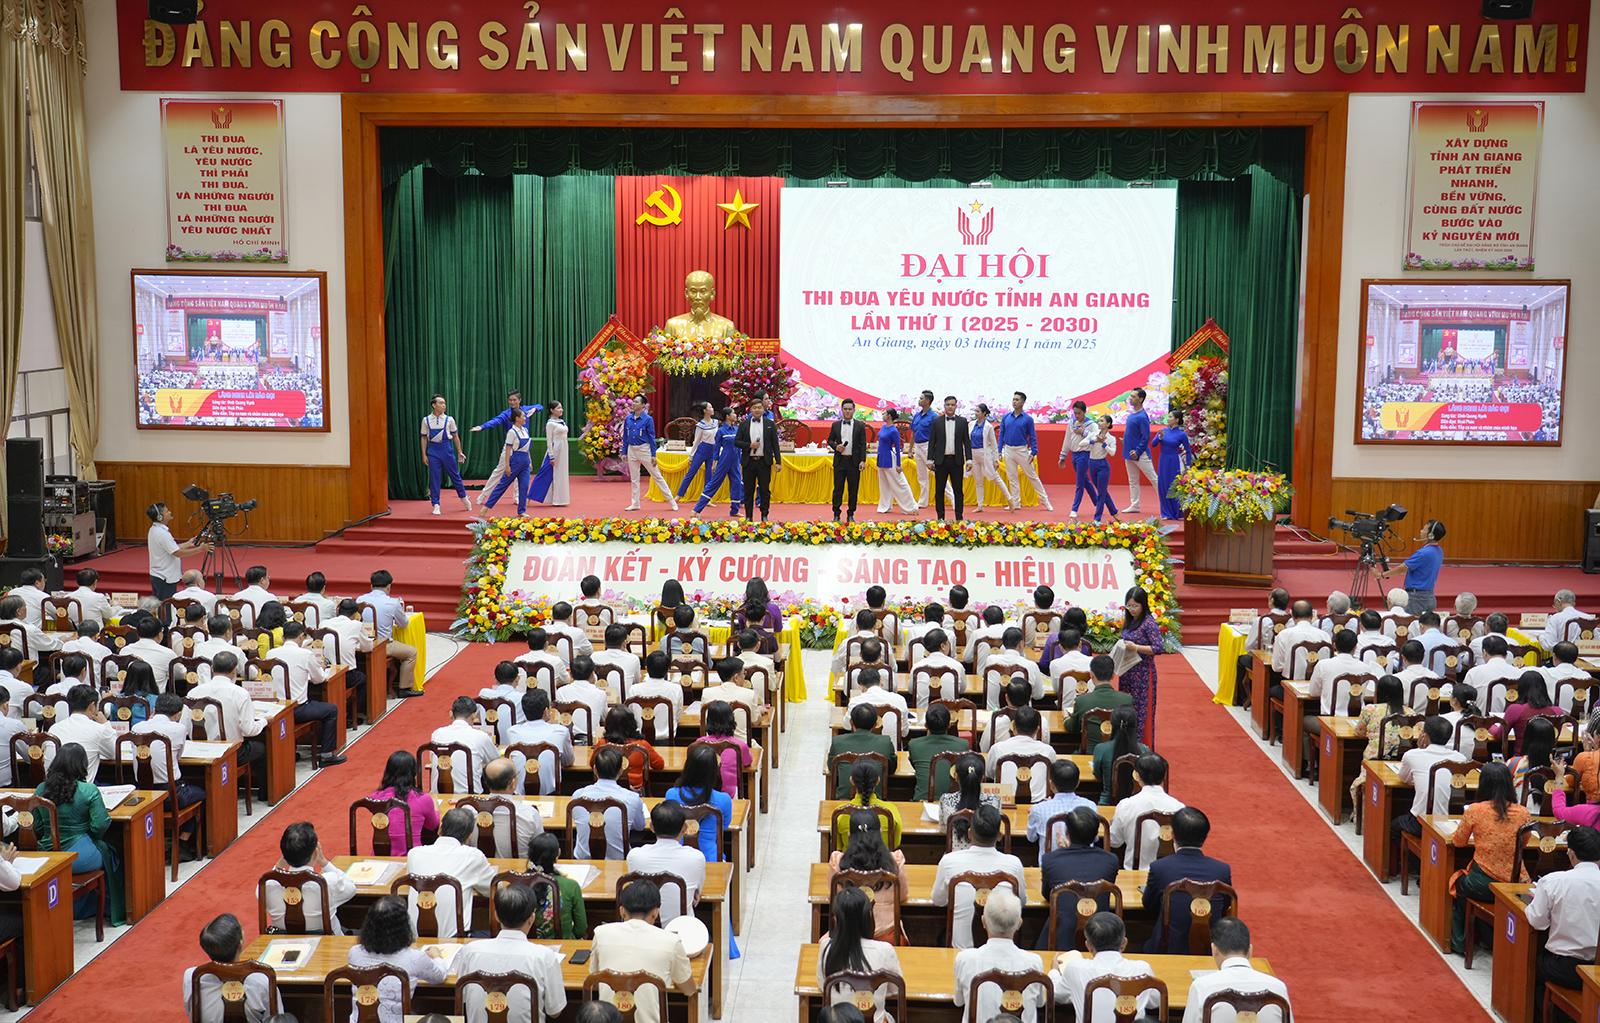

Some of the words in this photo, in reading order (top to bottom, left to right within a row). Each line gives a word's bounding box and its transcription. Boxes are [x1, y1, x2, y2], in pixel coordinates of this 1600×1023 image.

[309, 5, 459, 83] CỘNG
[478, 1, 587, 71] SẢN
[601, 8, 724, 84] VIỆT
[740, 23, 864, 72] NAM
[879, 23, 1077, 81] QUANG
[1095, 25, 1229, 73] VINH
[1243, 7, 1409, 74] MUÔN
[1446, 138, 1470, 148] XÂY
[1474, 139, 1508, 149] DỰNG
[184, 146, 198, 154] LÀ
[202, 146, 223, 154] YÊU
[1430, 150, 1458, 161] TỈNH
[1462, 152, 1480, 161] AN
[1484, 152, 1522, 161] GIANG
[195, 157, 217, 166] YÊU
[221, 157, 253, 166] NƯỚC
[221, 168, 248, 177] PHẢI
[1439, 164, 1471, 174] PHÁT
[1475, 163, 1511, 174] TRIỂN
[176, 191, 191, 200] VÀ
[194, 191, 234, 200] NHỮNG
[238, 191, 274, 200] NGƯỜI
[1441, 190, 1465, 201] BỀN
[203, 204, 221, 212] THI
[224, 204, 248, 212] ĐUA
[1424, 204, 1457, 214] CÙNG
[1461, 203, 1485, 214] ĐẤT
[1488, 204, 1522, 214] NƯỚC
[177, 214, 191, 222] LÀ
[195, 214, 235, 223] NHỮNG
[238, 215, 275, 223] NGƯỜI
[1441, 218, 1474, 227] BƯỚC
[1479, 218, 1503, 227] VÀO
[181, 225, 202, 234] YÊU
[206, 226, 238, 235] NƯỚC
[241, 225, 272, 235] NHẤT
[1441, 231, 1492, 241] NGUYÊN
[1496, 231, 1520, 241] MỚI
[900, 253, 967, 284] ĐẠI
[978, 246, 1050, 285] HỘI
[802, 290, 833, 305] THI
[840, 291, 879, 306] ĐUA
[887, 288, 925, 306] YÊU
[931, 289, 988, 307] NƯỚC
[995, 287, 1043, 307] TỈNH
[1049, 292, 1079, 307] AN
[1086, 292, 1150, 308] GIANG
[851, 311, 889, 330] LẦN
[897, 313, 937, 331] THỨ
[943, 316, 952, 331] I
[962, 316, 1019, 333] (2025
[1040, 317, 1098, 334] 2030)
[852, 336, 870, 348] An
[875, 336, 916, 351] Giang,
[920, 338, 951, 351] ngày
[954, 337, 970, 348] 03
[974, 337, 1010, 351] tháng
[1015, 338, 1028, 348] 11
[1034, 338, 1062, 349] năm
[1066, 338, 1097, 350] 2025
[523, 552, 597, 582] ĐOÀN
[604, 548, 652, 582] KẾT
[677, 548, 712, 582] KỶ
[719, 553, 809, 583] CƯƠNG
[837, 553, 909, 585] SÁNG
[917, 558, 967, 591] TẠO
[995, 555, 1055, 593] HIỆU
[1064, 554, 1119, 592] QUẢ
[280, 722, 286, 737] A
[222, 765, 227, 782] B
[146, 816, 152, 833] C
[1431, 843, 1437, 861] C
[49, 885, 57, 904] D
[1507, 916, 1515, 937] D
